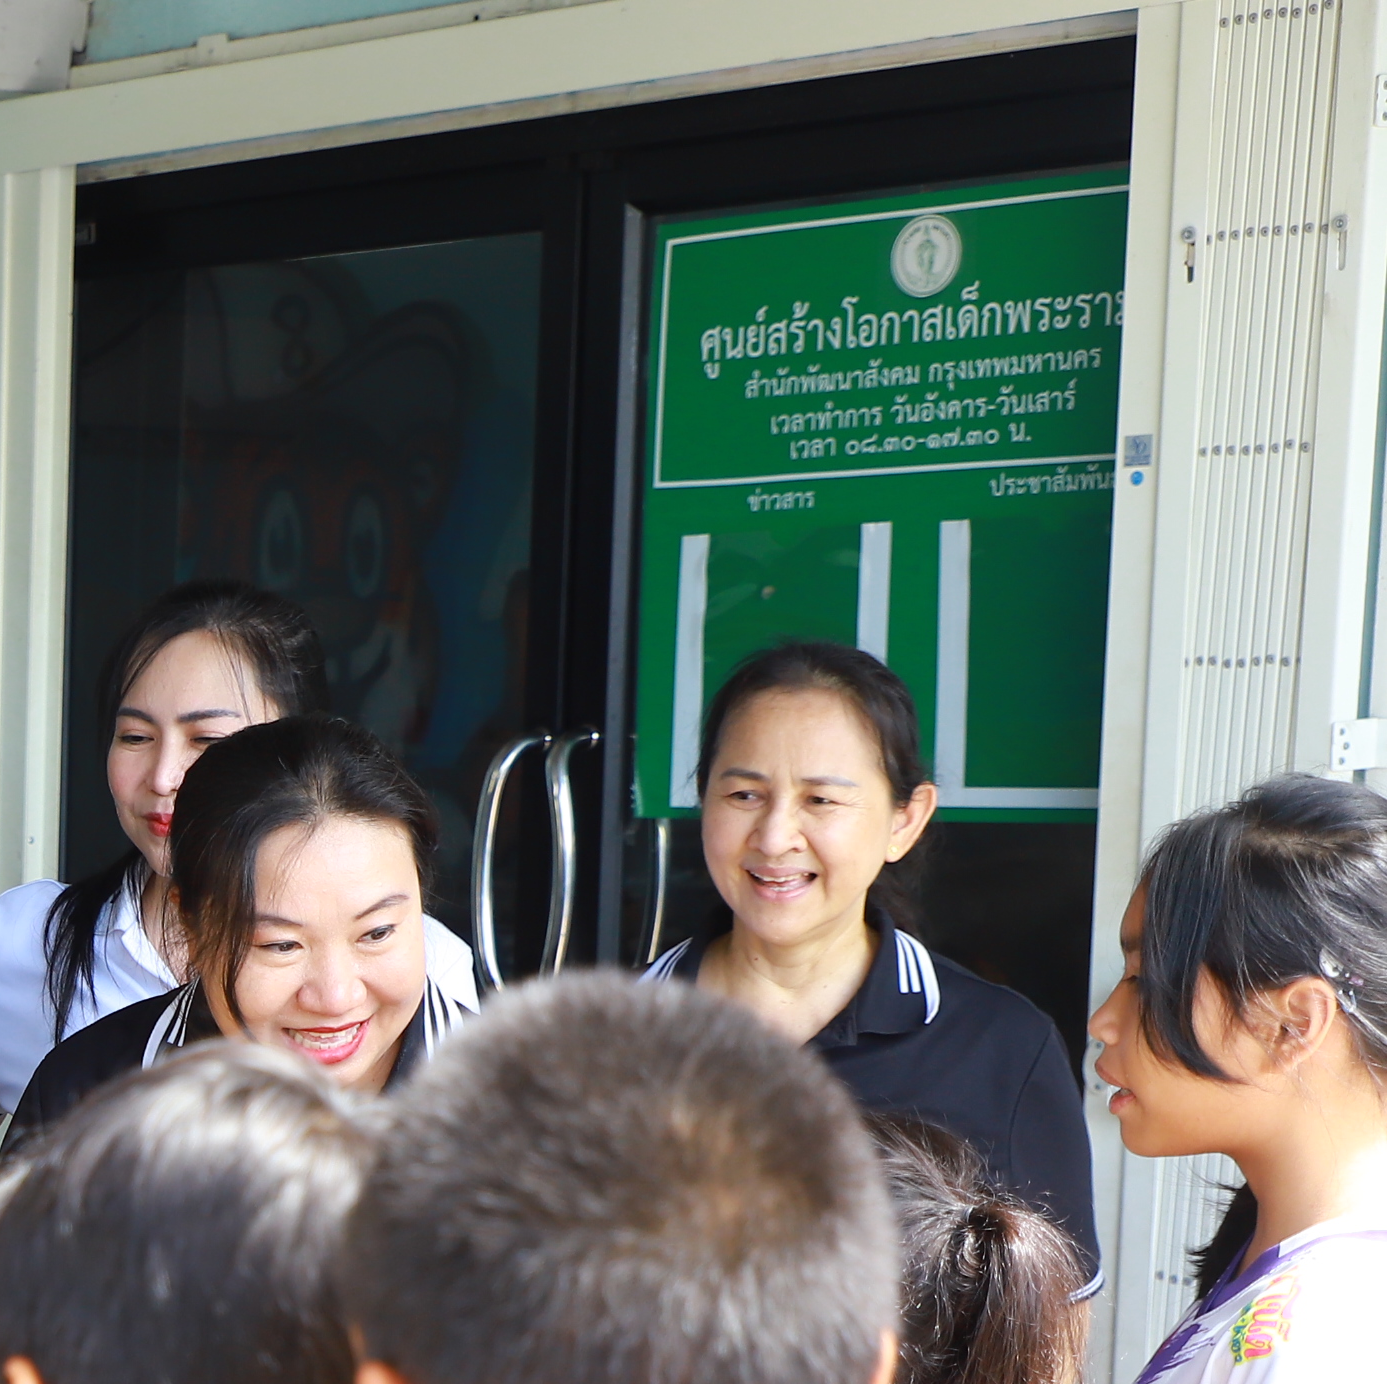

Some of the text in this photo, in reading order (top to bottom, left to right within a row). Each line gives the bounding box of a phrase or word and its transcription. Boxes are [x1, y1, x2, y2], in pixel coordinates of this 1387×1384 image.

[744, 345, 1103, 400] สำนักพัฒนาสังคม กรุงเทพมหานคร
[770, 377, 1078, 436] เวลาทำการ วันอังคาร-วันเสาร์
[789, 435, 837, 461] เวลา
[1008, 420, 1033, 444] น.
[746, 487, 816, 513] ข่าวสาร
